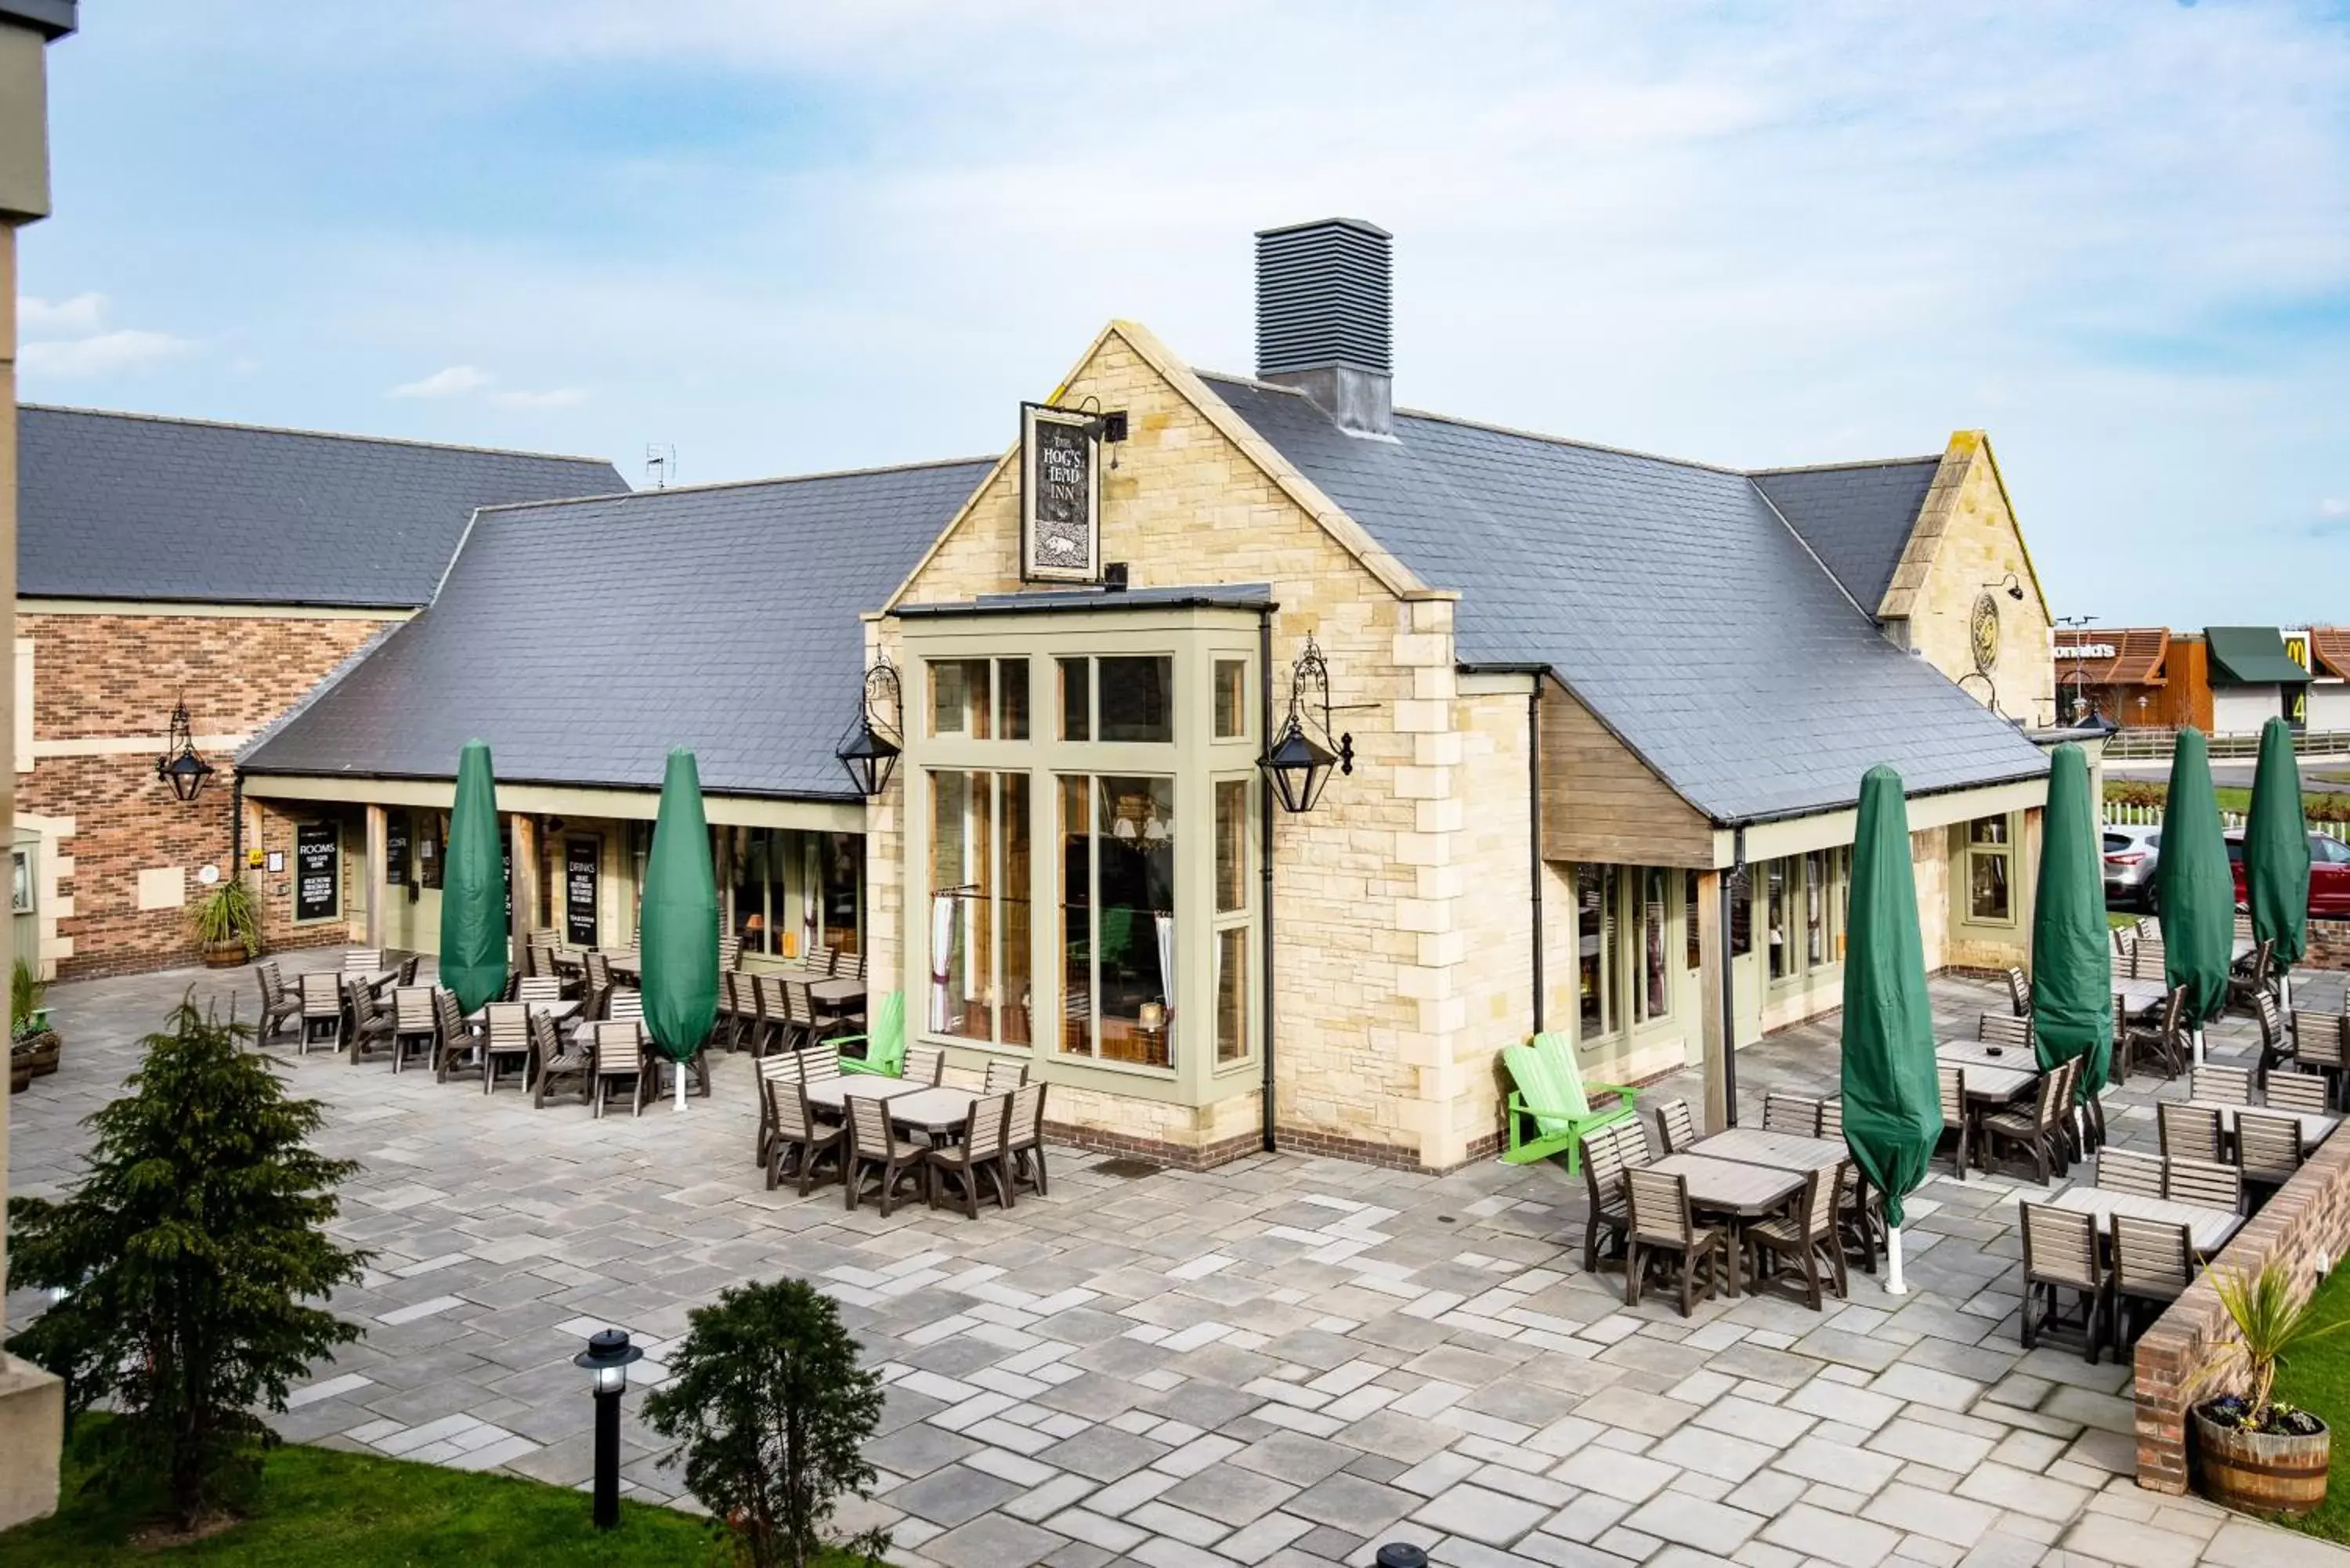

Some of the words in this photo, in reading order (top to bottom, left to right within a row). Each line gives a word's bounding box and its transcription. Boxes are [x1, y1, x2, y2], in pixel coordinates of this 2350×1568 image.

[1043, 447, 1082, 468] HOG'S
[1050, 484, 1075, 500] INN
[300, 842, 336, 855] ROOMS
[569, 861, 596, 873] DRINKS
